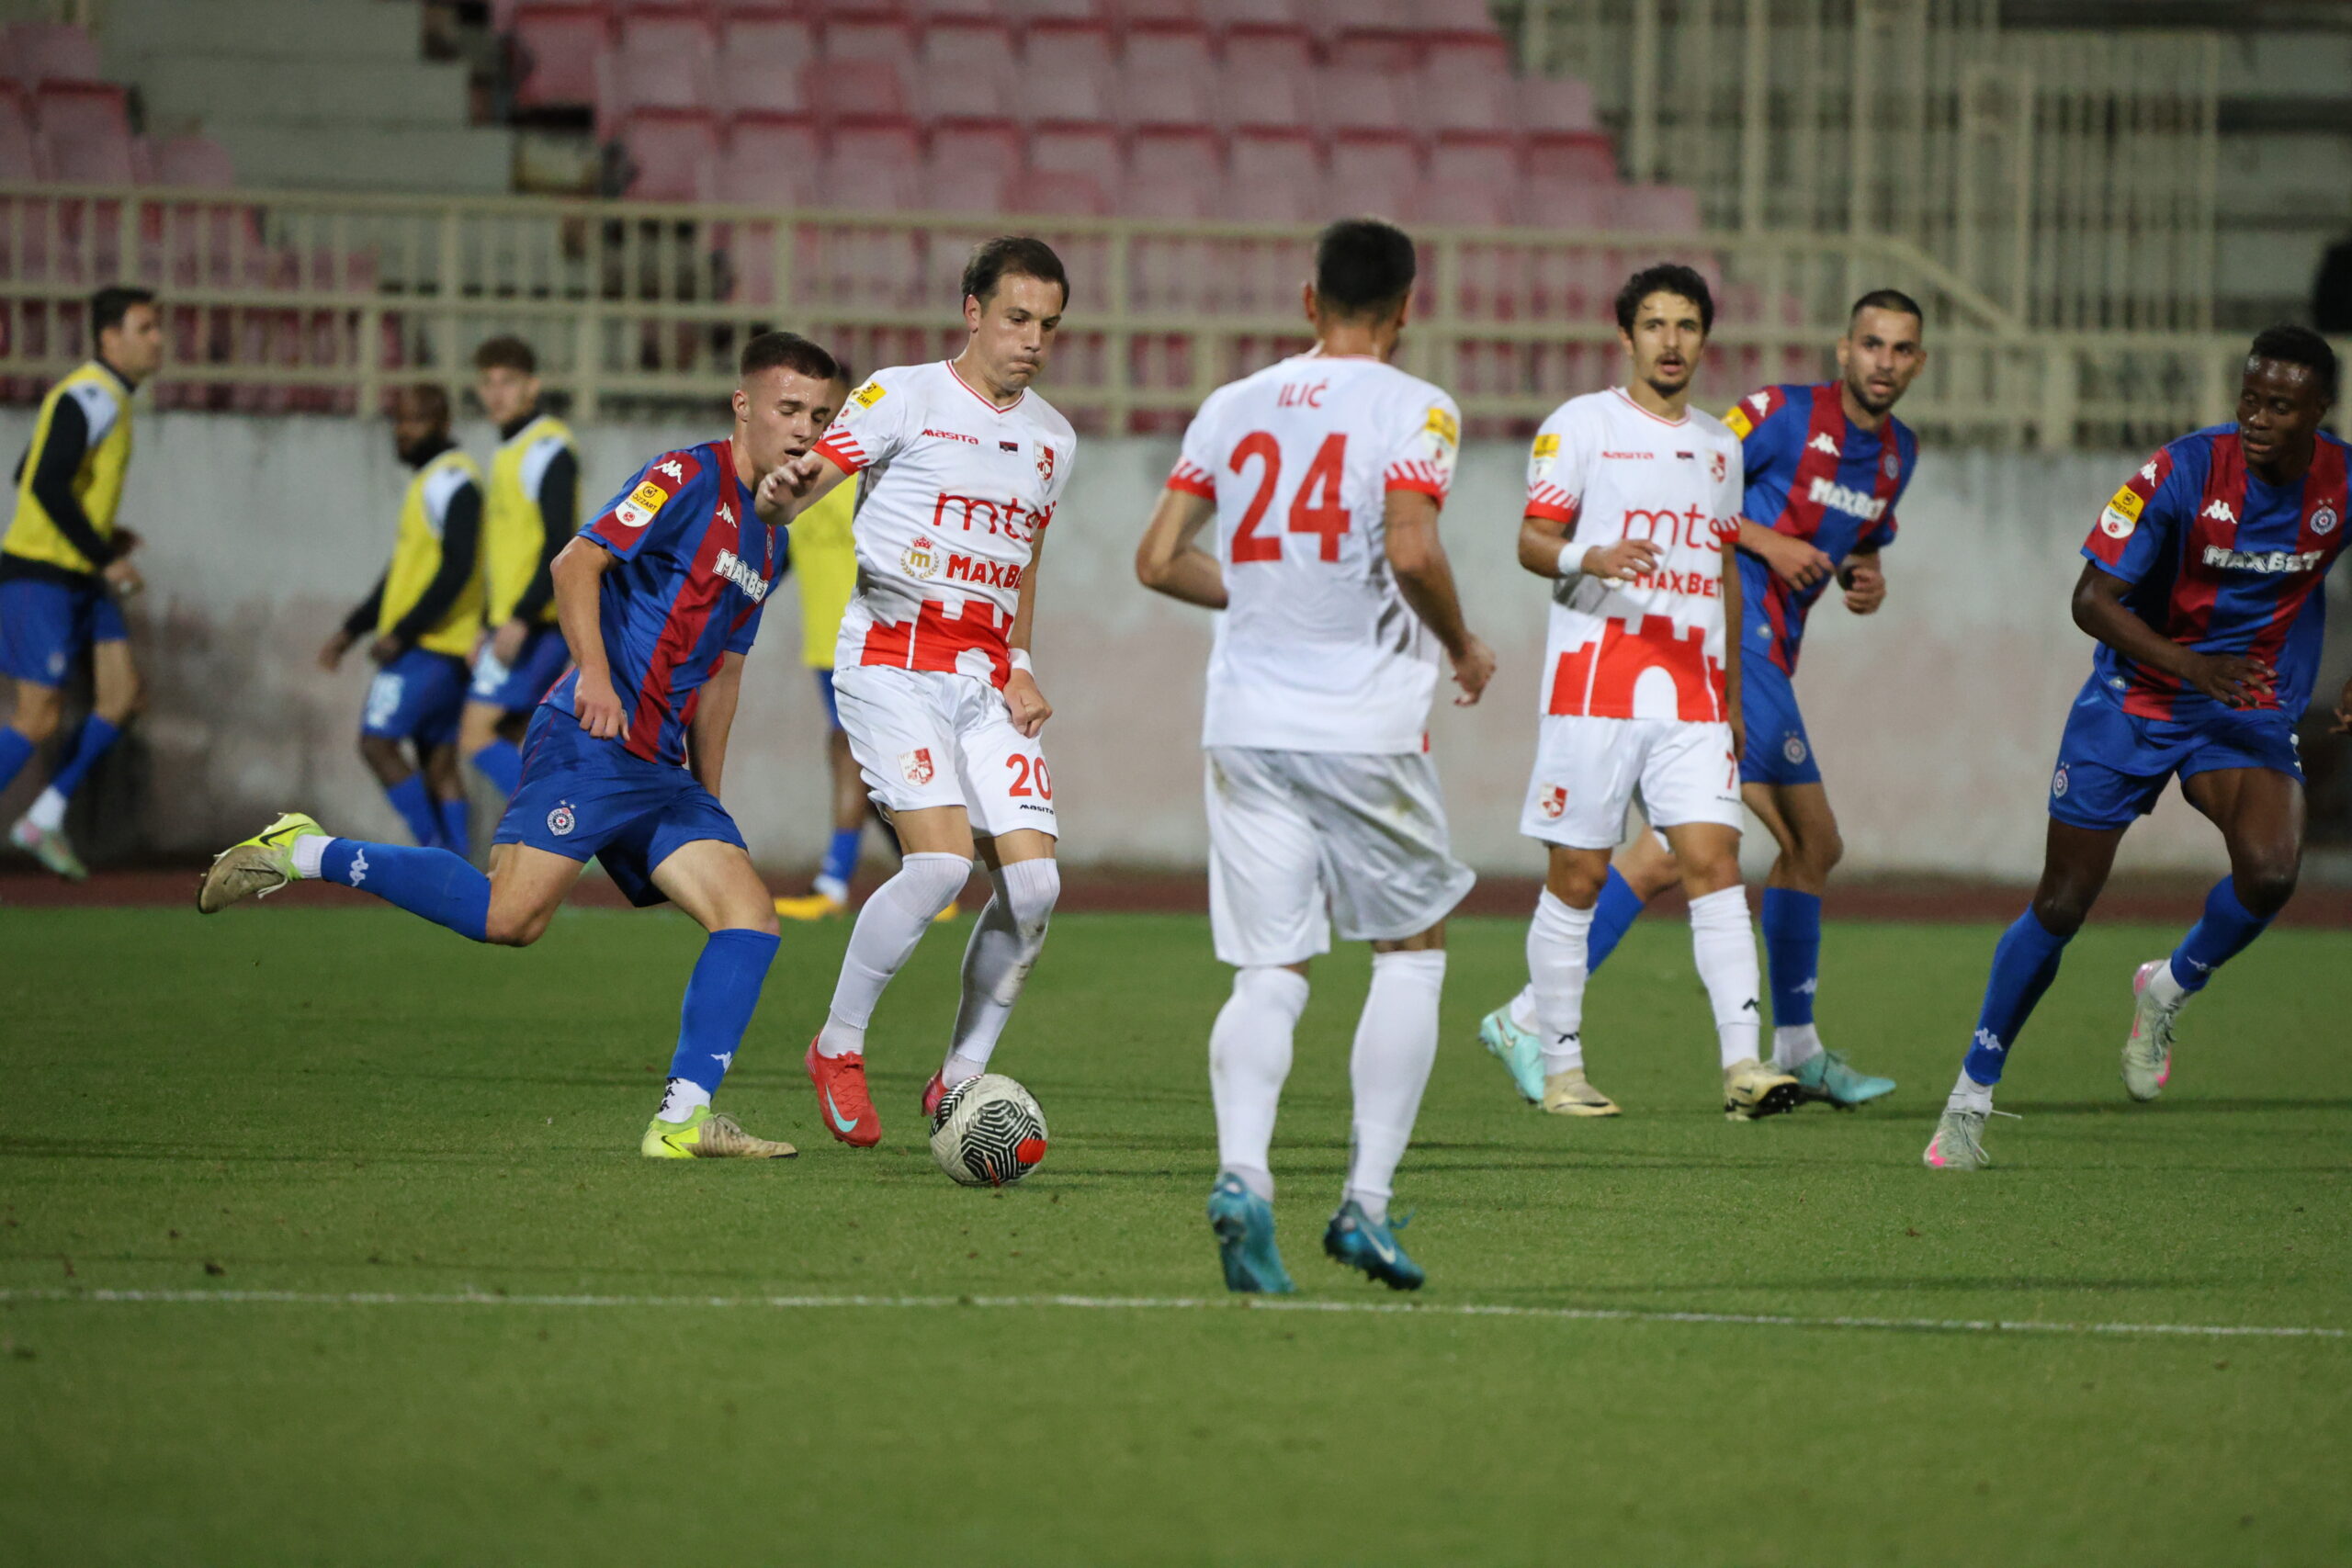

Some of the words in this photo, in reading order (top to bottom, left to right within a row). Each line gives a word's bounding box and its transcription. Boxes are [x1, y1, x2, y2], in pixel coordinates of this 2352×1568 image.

[1277, 378, 1329, 408] ILIĆ
[1228, 431, 1351, 564] 24
[1006, 753, 1052, 801] 20
